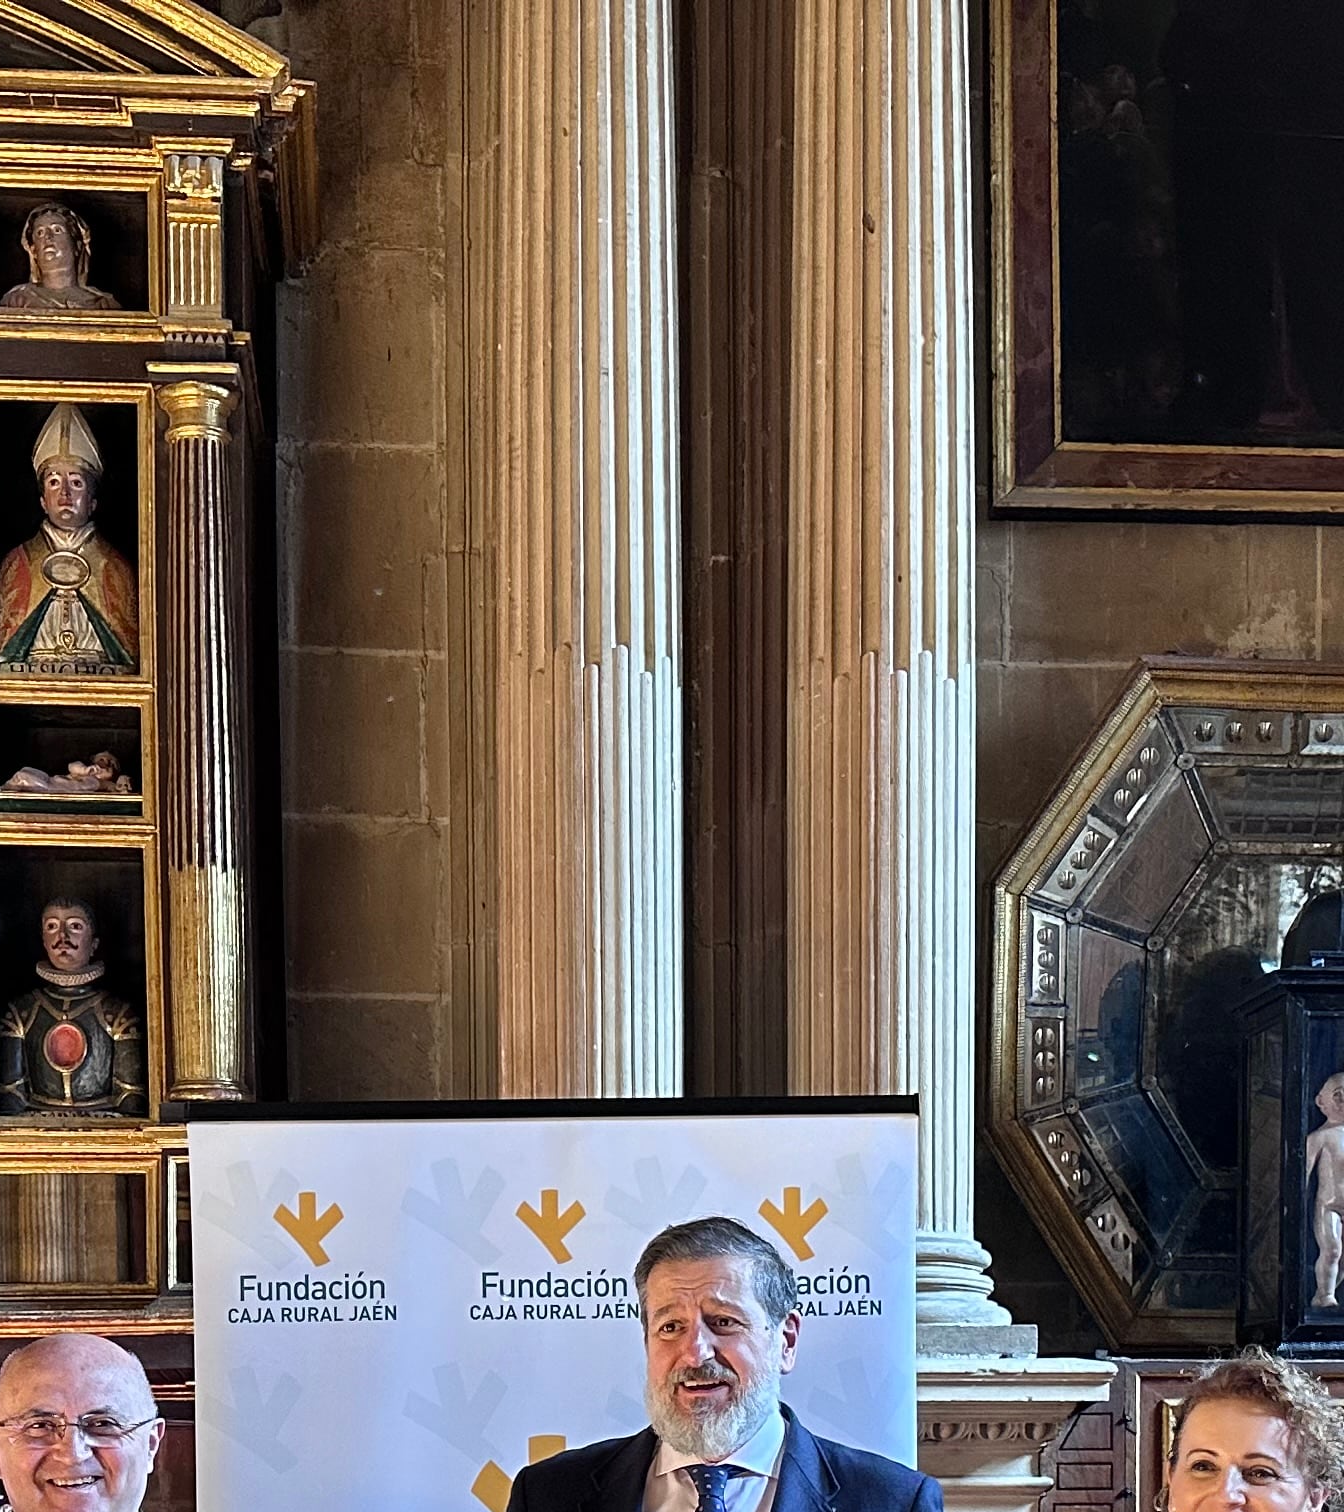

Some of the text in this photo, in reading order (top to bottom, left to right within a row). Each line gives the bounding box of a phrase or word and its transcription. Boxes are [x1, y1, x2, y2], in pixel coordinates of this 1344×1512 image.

[240, 1272, 386, 1301] Fundación
[482, 1269, 628, 1298] Fundación
[796, 1266, 870, 1295] ación
[228, 1301, 397, 1323] CAJA RURAL JAÉN
[470, 1299, 639, 1320] CAJA RURAL JAÉN
[793, 1295, 882, 1316] RAL JAÉN
